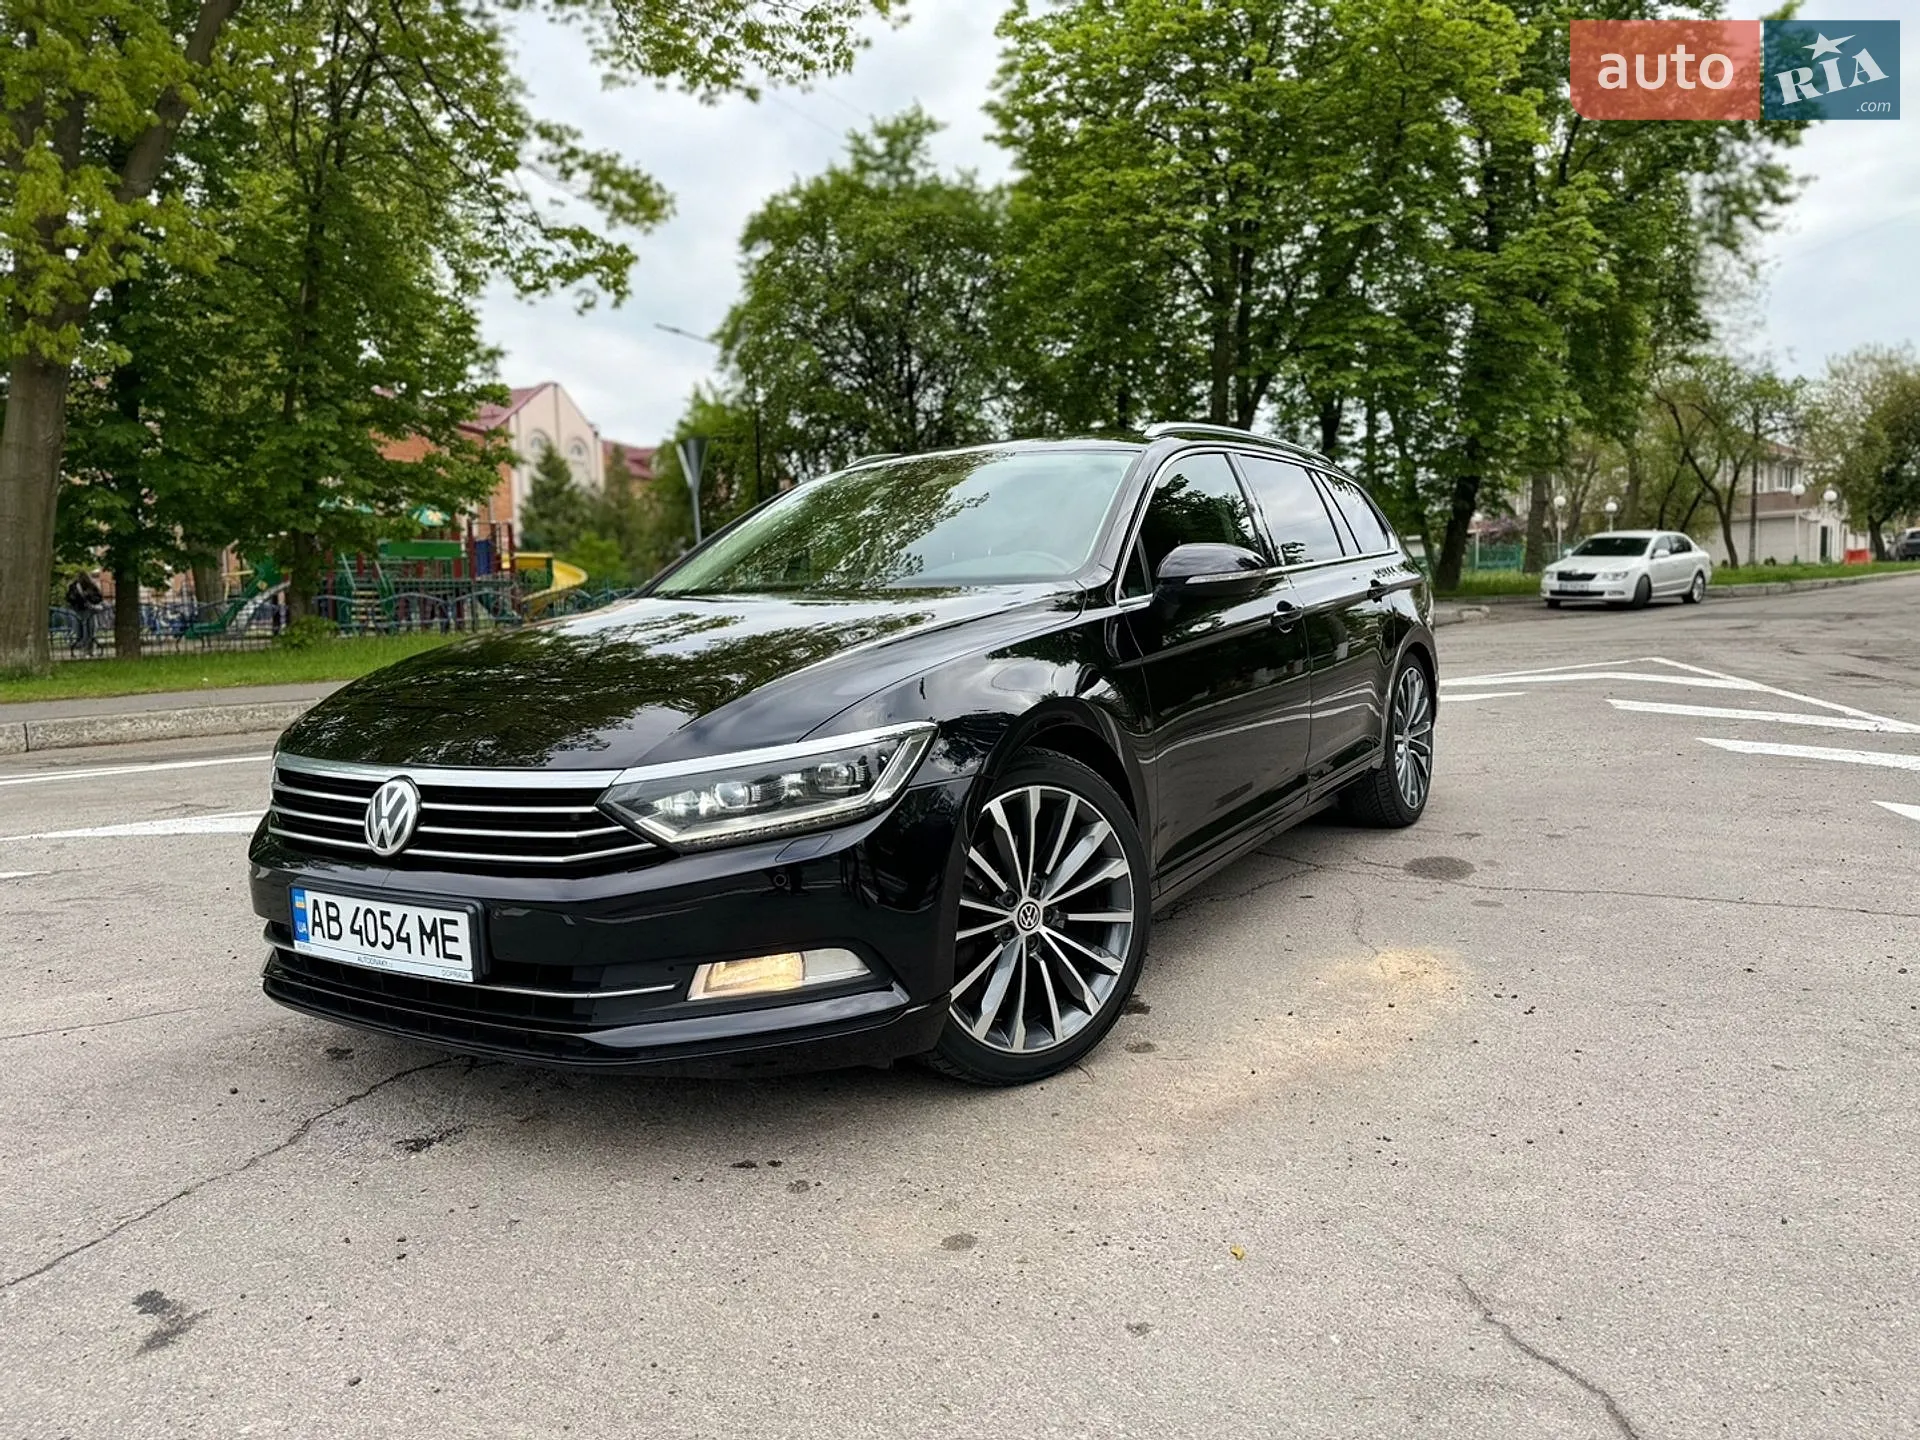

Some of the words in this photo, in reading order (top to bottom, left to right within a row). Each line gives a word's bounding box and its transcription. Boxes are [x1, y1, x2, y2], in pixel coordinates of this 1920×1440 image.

[311, 899, 343, 941] AB
[350, 906, 411, 954] 4054
[418, 914, 463, 962] ME
